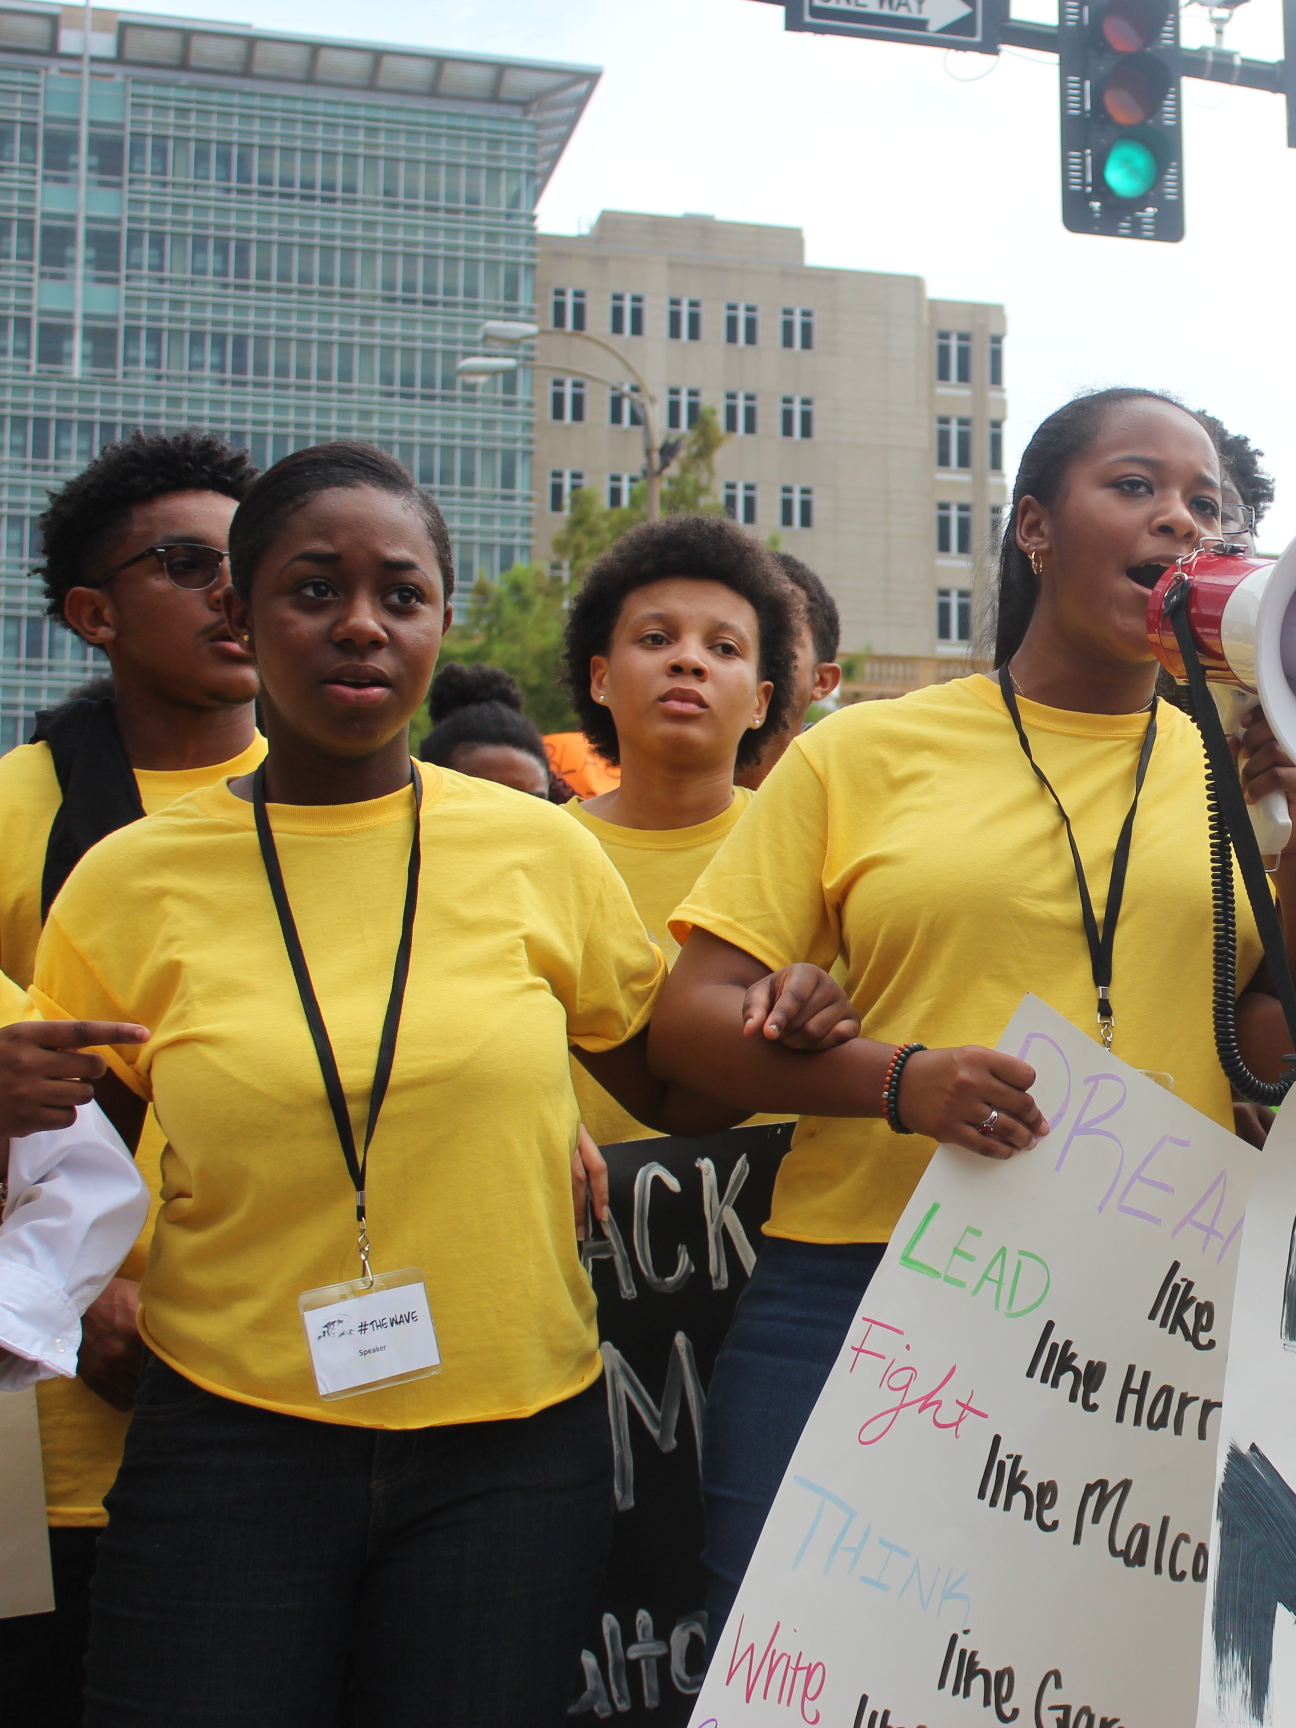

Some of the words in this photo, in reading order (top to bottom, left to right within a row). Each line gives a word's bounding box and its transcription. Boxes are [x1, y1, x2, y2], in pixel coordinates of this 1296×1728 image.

[900, 1202, 1051, 1318] LEAD
[1148, 1260, 1216, 1351] like
[359, 1344, 386, 1356] Speaker
[849, 1316, 989, 1445] Fight
[1026, 1320, 1107, 1412] like
[1115, 1363, 1222, 1440] Harr
[791, 1475, 970, 1622] THINK
[977, 1434, 1059, 1532] like
[1072, 1478, 1209, 1583] Malco
[726, 1614, 826, 1725] Write
[938, 1629, 1019, 1724] like
